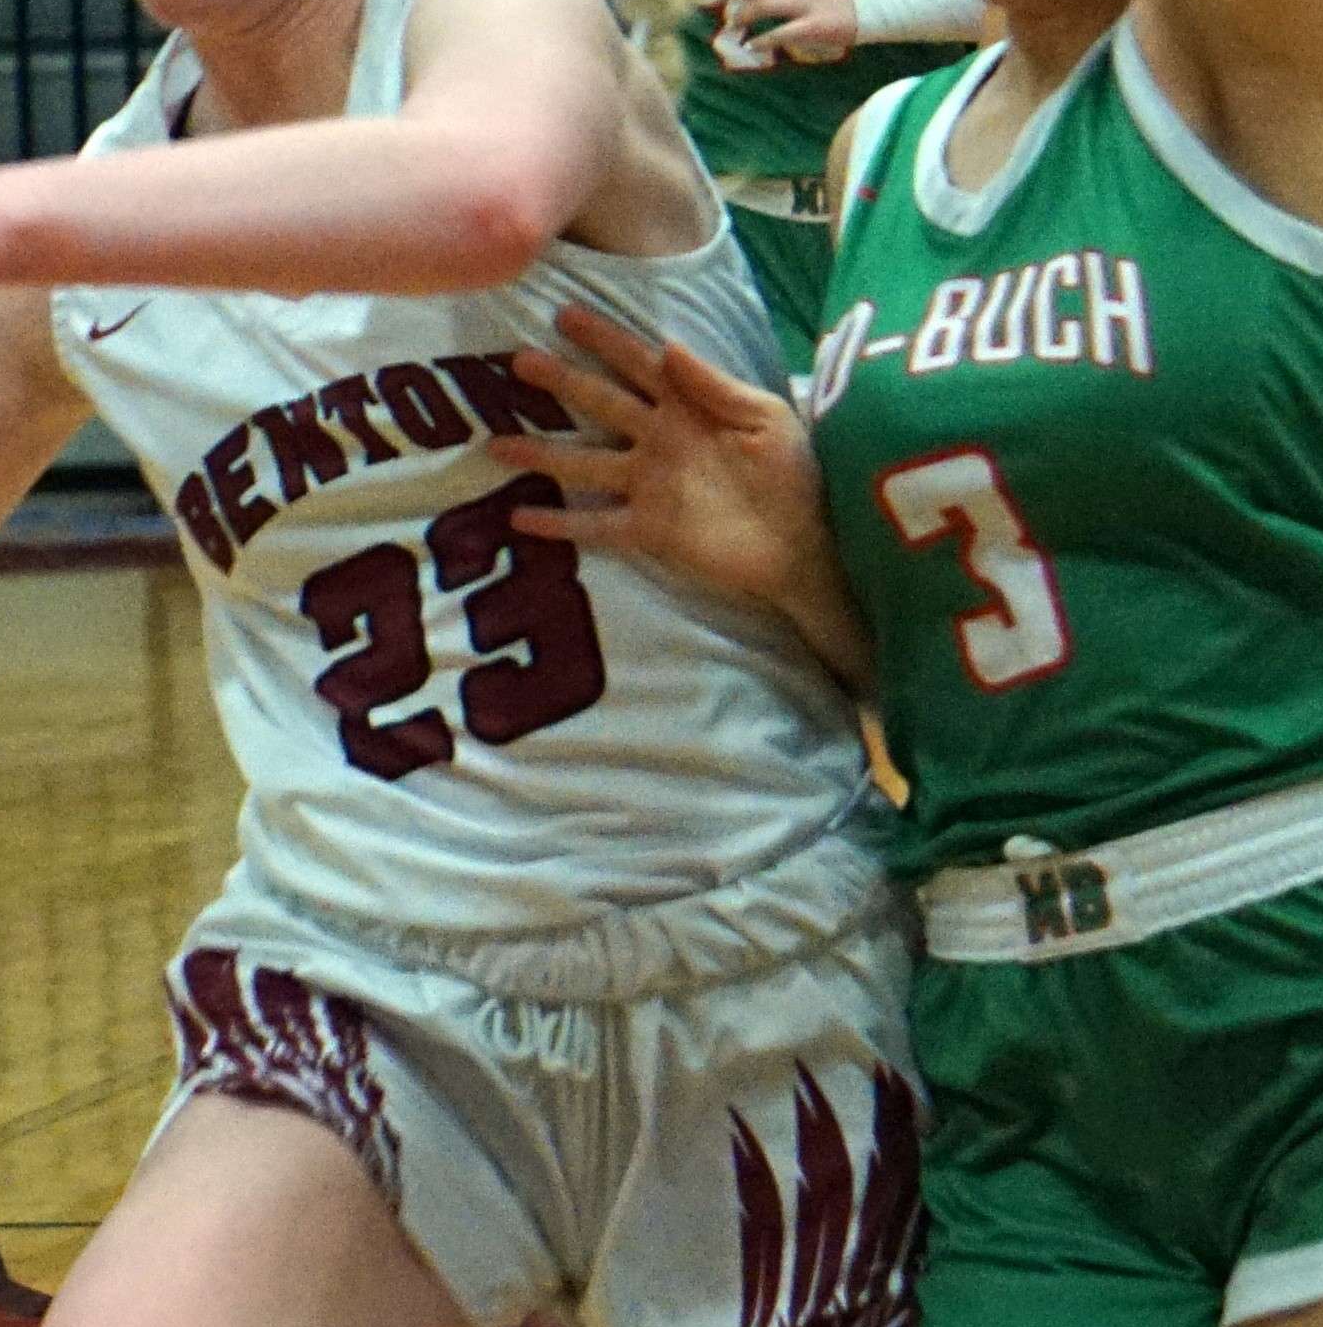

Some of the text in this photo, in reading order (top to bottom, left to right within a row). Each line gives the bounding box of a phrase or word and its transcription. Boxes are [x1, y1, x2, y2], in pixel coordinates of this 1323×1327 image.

[175, 349, 578, 579] BENTON
[876, 442, 1074, 697] 3
[299, 470, 606, 782] 23
